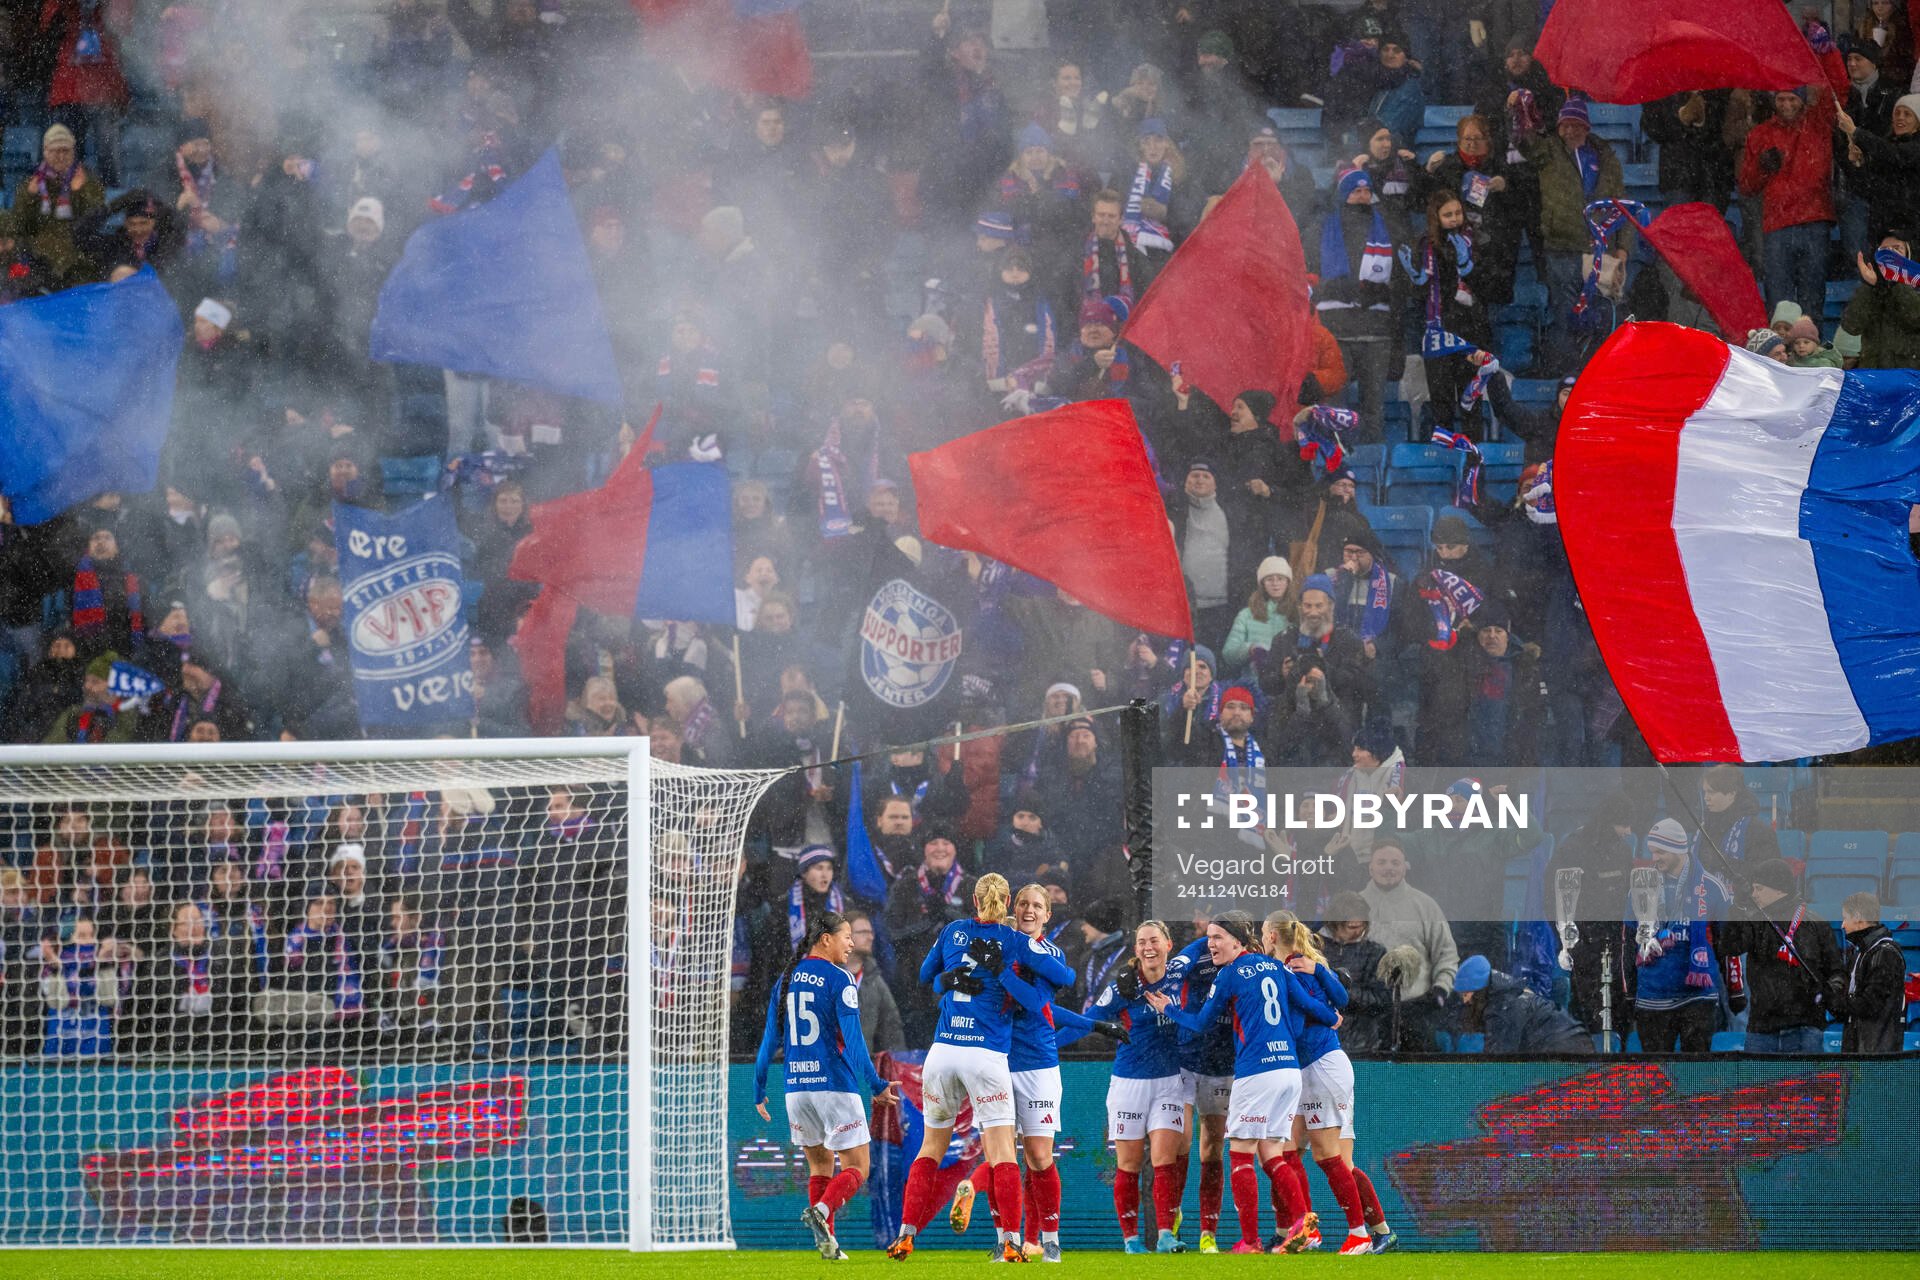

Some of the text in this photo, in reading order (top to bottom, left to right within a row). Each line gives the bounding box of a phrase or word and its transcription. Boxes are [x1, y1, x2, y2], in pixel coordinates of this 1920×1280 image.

[793, 972, 825, 987] OBOS
[1260, 976, 1282, 1027] 8
[786, 991, 821, 1046] 15
[950, 1015, 975, 1029] HØRTE
[940, 1031, 985, 1042] mot rasisme
[1261, 1055, 1277, 1064] mot
[789, 1060, 820, 1073] TENNEBØ
[799, 1076, 828, 1085] rasisme
[976, 1091, 1009, 1105] Scandic
[1116, 1123, 1125, 1134] 19
